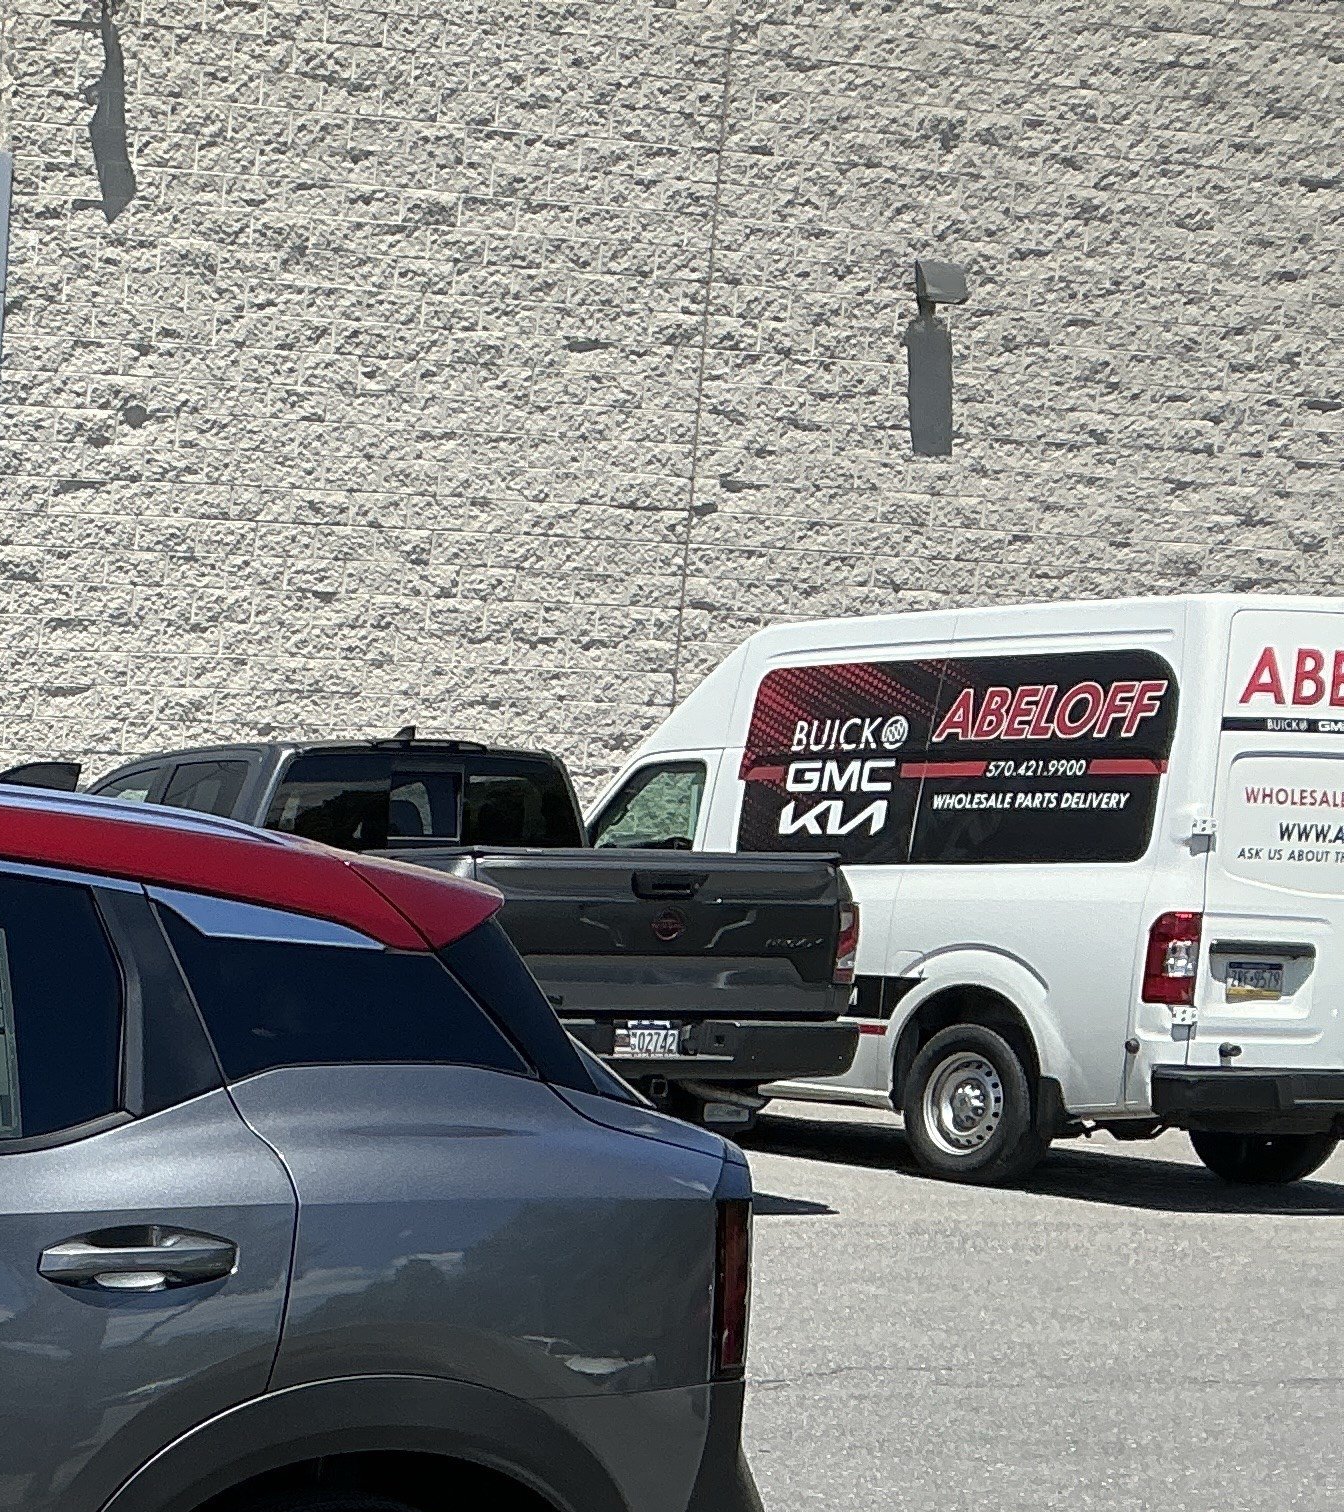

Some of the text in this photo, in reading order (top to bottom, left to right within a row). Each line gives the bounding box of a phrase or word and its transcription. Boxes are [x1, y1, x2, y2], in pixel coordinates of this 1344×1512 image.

[932, 681, 1169, 743] ABELOFF
[790, 717, 883, 752] BUICK
[1267, 719, 1344, 732] BUICK GM
[785, 758, 897, 791] GMC
[985, 760, 1087, 778] 570.421.9900
[932, 791, 1131, 811] WHOLESALE PARTS DELIVERY
[778, 799, 889, 836] KIA
[1237, 848, 1264, 860] ASK
[1268, 849, 1283, 861] US
[1287, 850, 1330, 863] ABOUT
